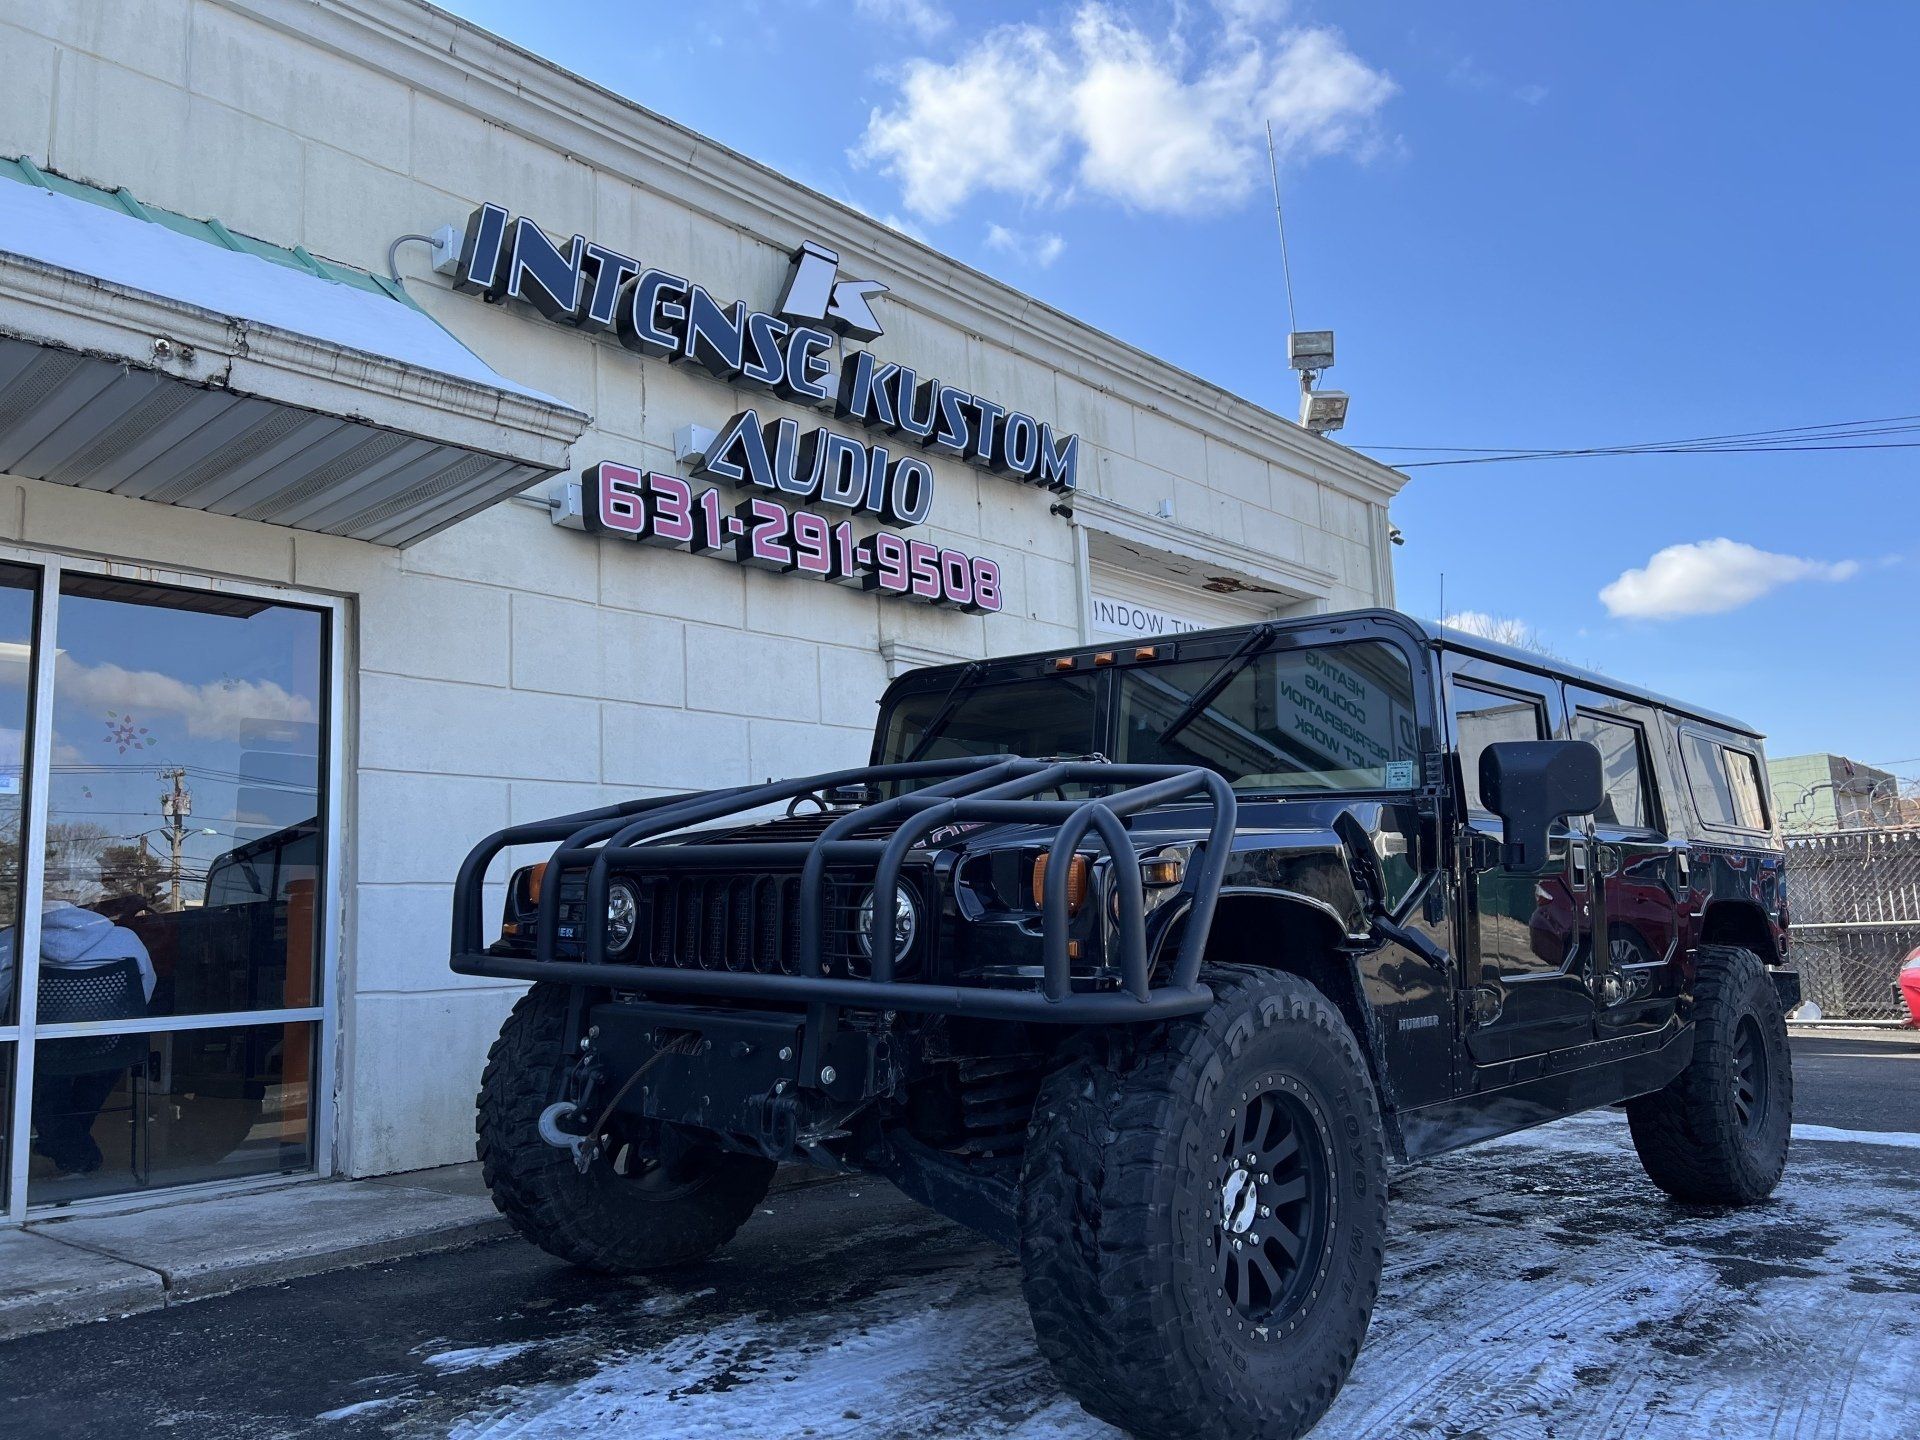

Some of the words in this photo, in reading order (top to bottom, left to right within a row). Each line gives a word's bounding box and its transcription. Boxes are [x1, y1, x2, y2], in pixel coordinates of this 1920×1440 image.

[466, 202, 834, 400] INTENSE
[849, 350, 1080, 490] KUSTOM
[706, 408, 935, 526] AUDIO
[598, 461, 1003, 612] 631-291-9508
[1093, 600, 1164, 634] INDOW
[1336, 1087, 1368, 1200] TOYO
